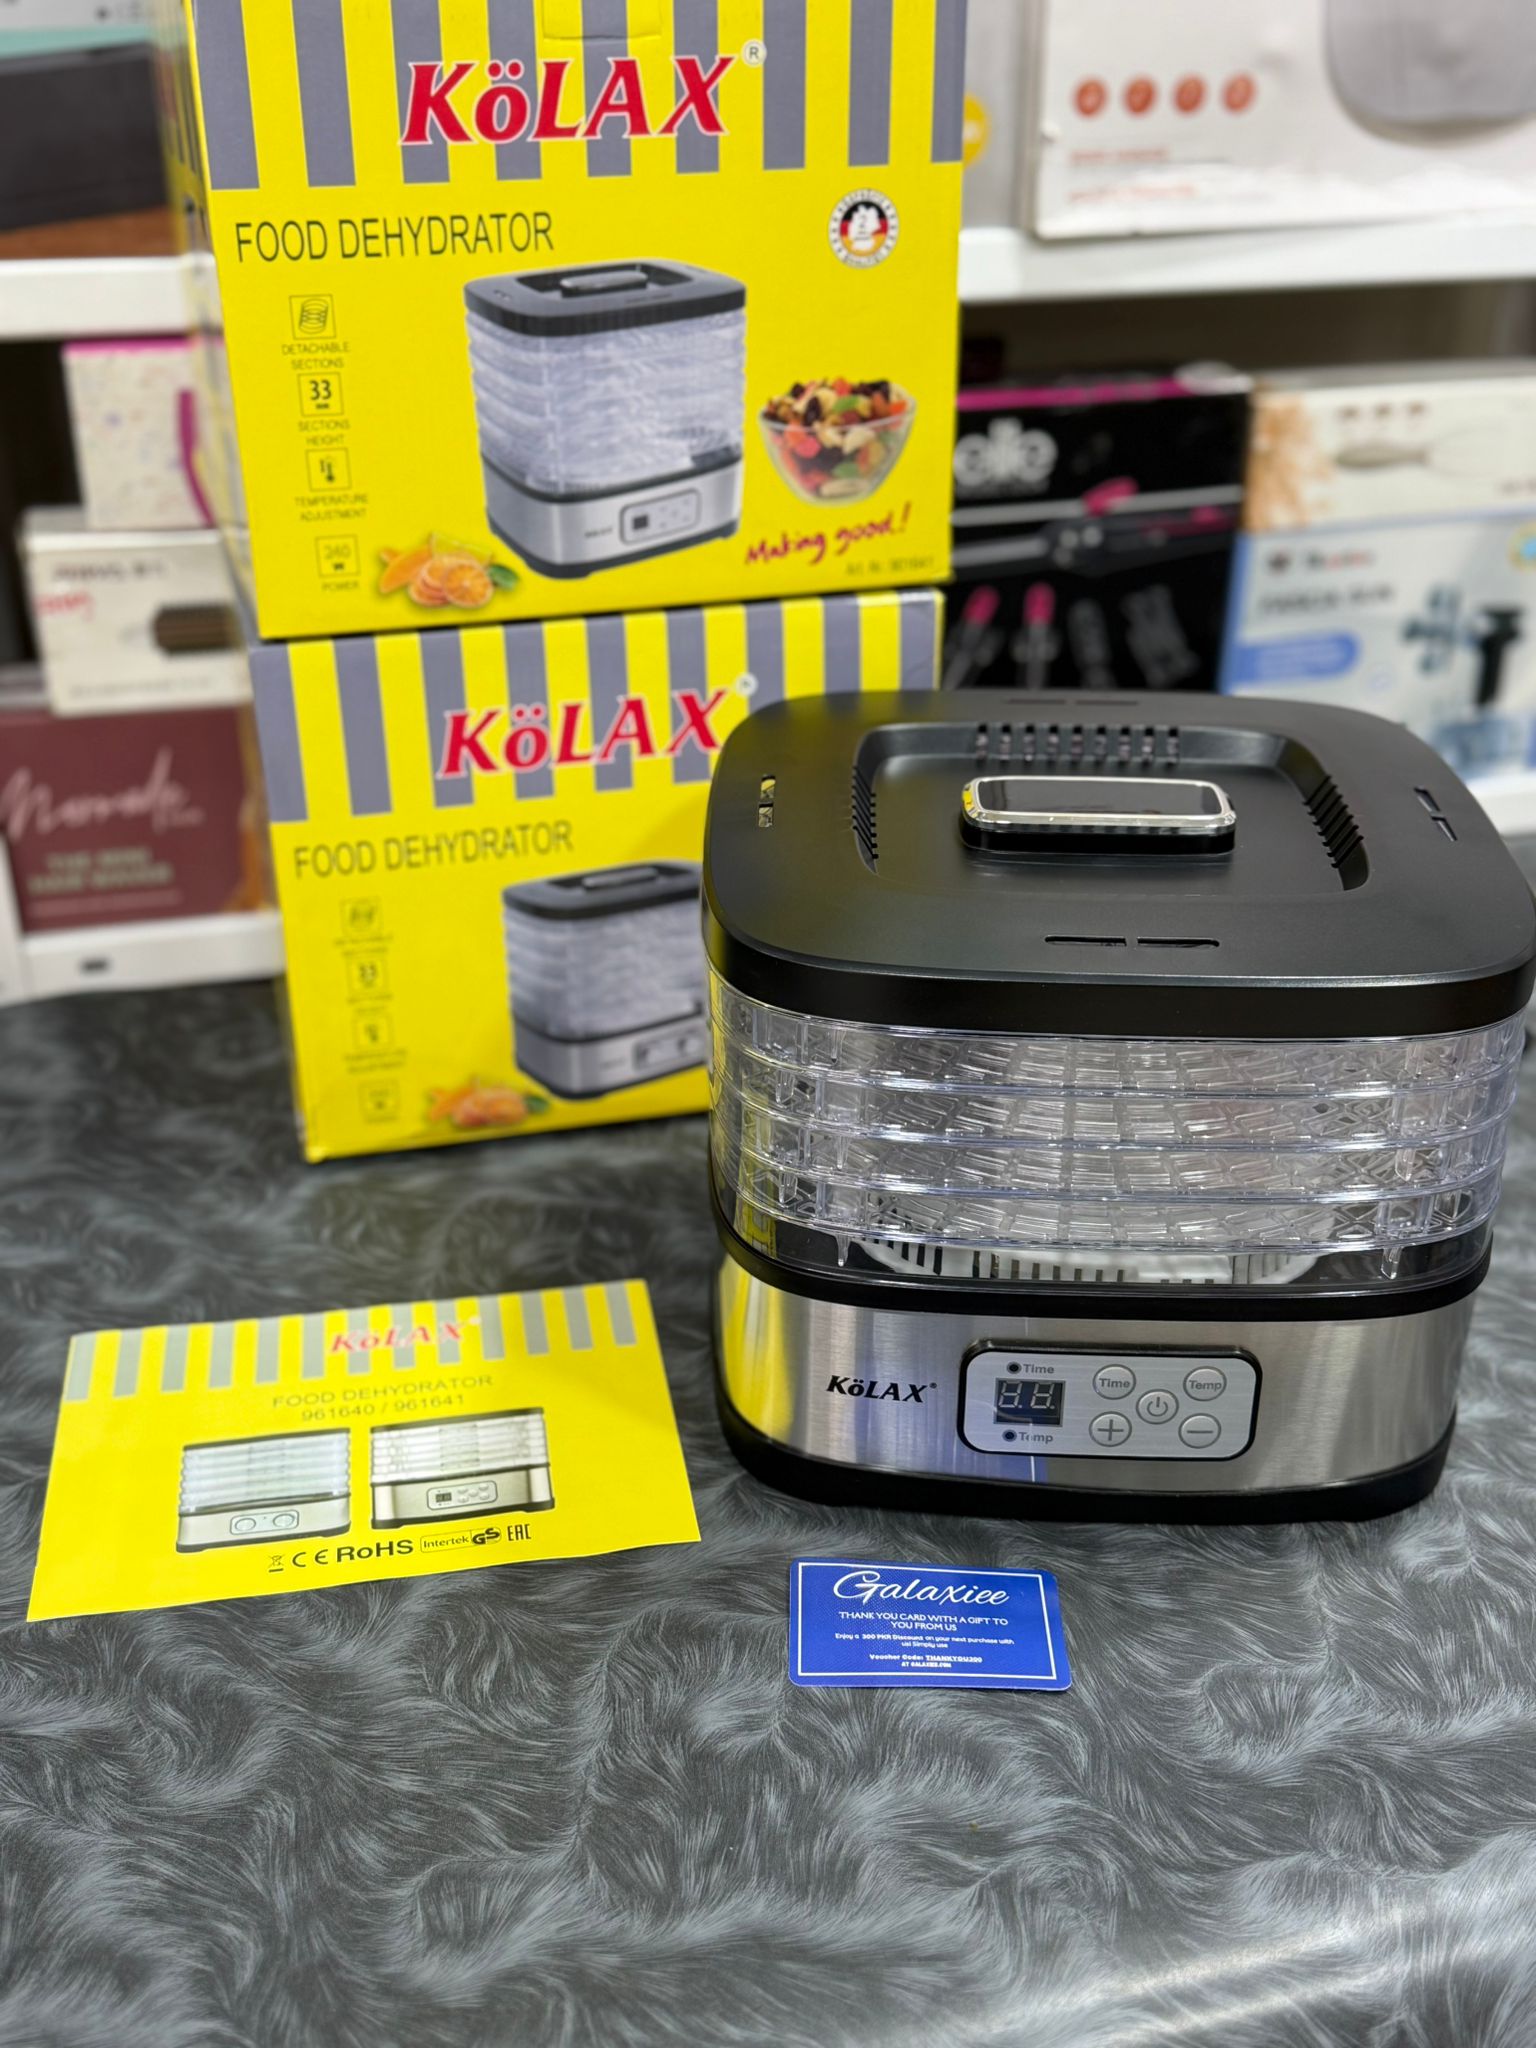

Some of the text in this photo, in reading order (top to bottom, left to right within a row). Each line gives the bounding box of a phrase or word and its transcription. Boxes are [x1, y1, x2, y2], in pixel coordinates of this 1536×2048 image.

[235, 211, 554, 263] FOOD DEHYDRATOR
[281, 341, 350, 355] DETACHABLE
[291, 357, 344, 370] SECTIONS
[309, 379, 332, 401] 33
[298, 418, 350, 432] SECTIONS
[305, 434, 345, 446] HEIGHT
[294, 493, 368, 507] TEMPERATURE
[299, 508, 367, 522] ADJUSTMENT
[744, 530, 826, 566] Making
[321, 580, 359, 592] POWER
[292, 819, 575, 880] FOOD DEHYDRATOR
[1023, 1363, 1055, 1374] Time
[272, 1374, 494, 1408] FOOD DEHYDRATOR
[1099, 1377, 1222, 1391] Time Temp
[301, 1404, 375, 1421] 961640
[393, 1394, 465, 1413] 961641
[336, 1539, 414, 1563] RoHS
[423, 1533, 470, 1549] Intertek
[833, 1570, 1010, 1606] Galaxiee
[839, 1611, 1008, 1626] THANK YOU CARD WITH A GIFT TO
[890, 1621, 957, 1631] YOU FROM US
[834, 1632, 854, 1641] Enjoy
[862, 1633, 876, 1641] 300
[869, 1653, 901, 1661] Voucher
